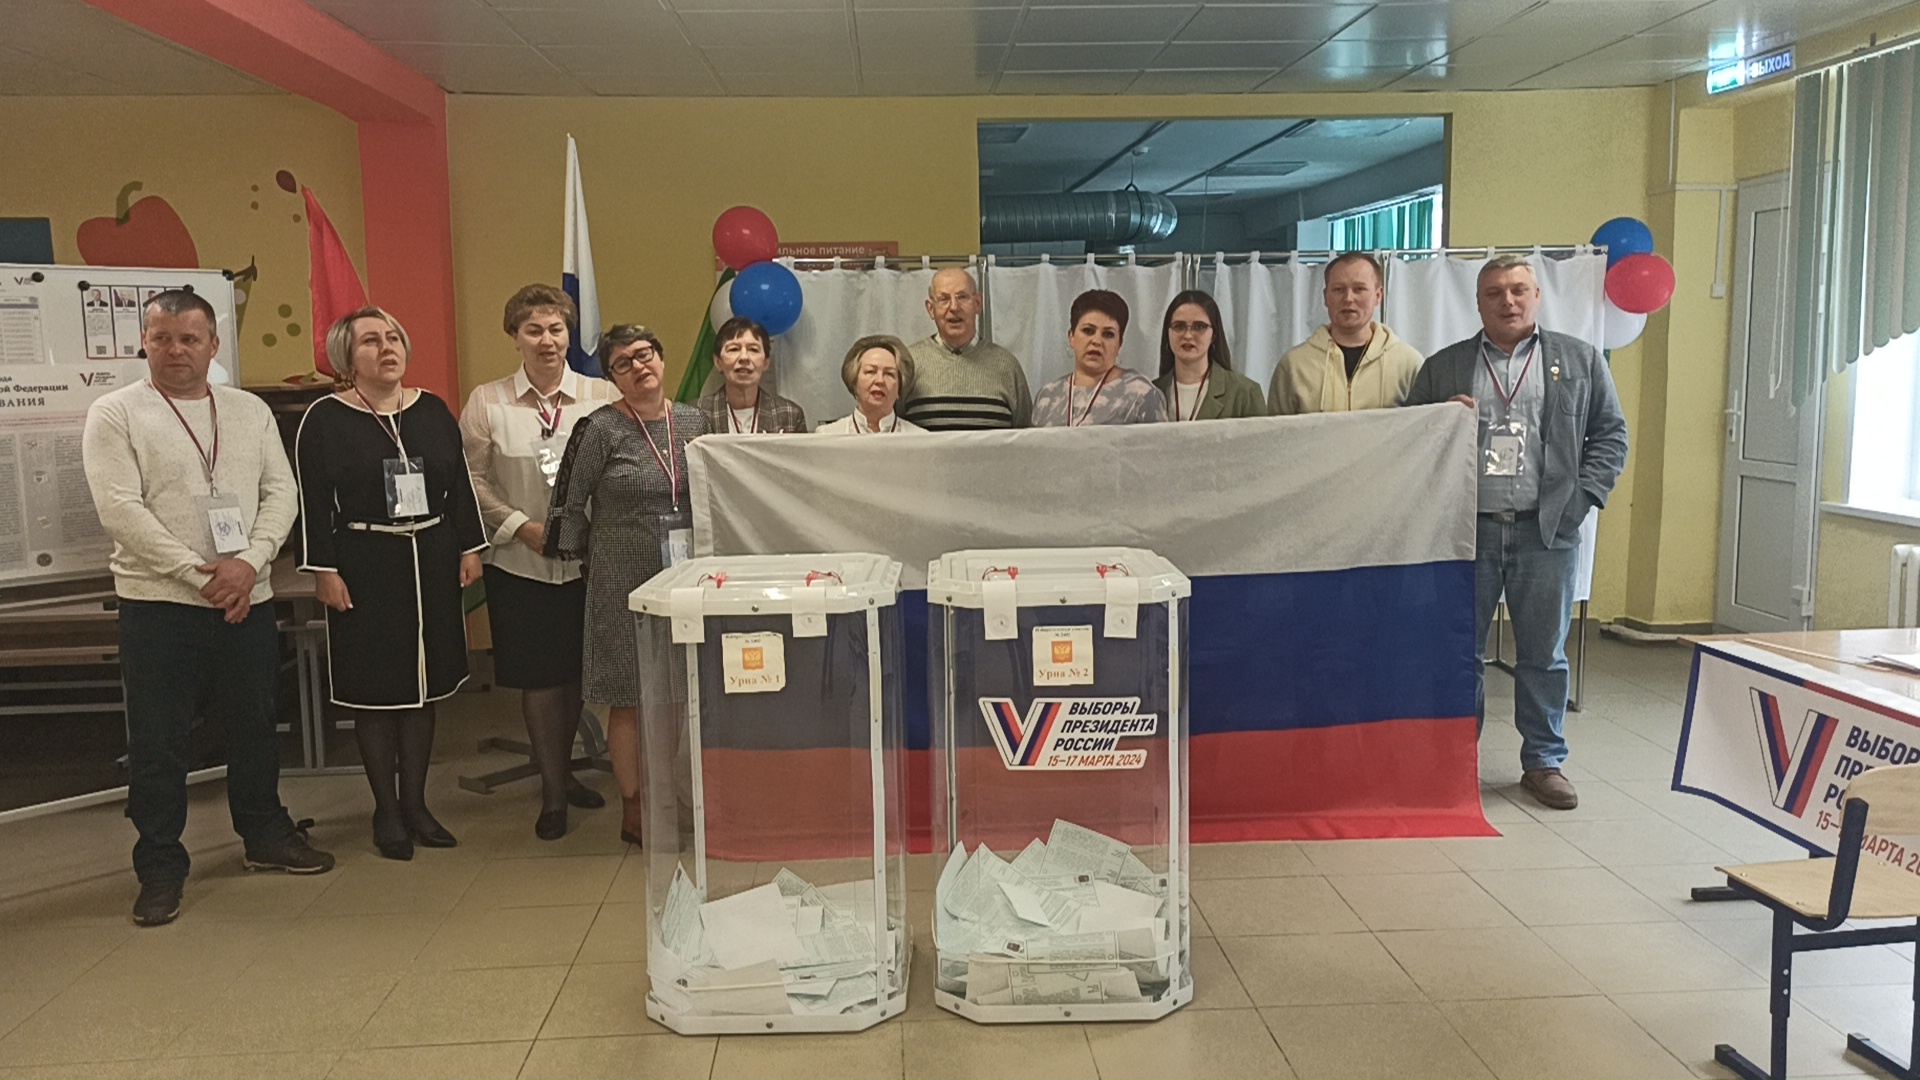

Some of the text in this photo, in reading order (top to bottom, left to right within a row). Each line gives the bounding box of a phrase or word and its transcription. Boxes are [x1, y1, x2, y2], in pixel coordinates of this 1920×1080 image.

[819, 246, 865, 255] питание
[13, 384, 68, 394] Федерации
[1038, 668, 1066, 680] Урна
[1083, 667, 1089, 677] 2
[729, 676, 757, 687] Урна
[1068, 702, 1136, 716] ВЫБОРЫ
[1060, 718, 1155, 734] ПРЕЗИДЕНТА
[1053, 738, 1115, 751] РОССИИ
[1078, 755, 1114, 767] МАРТА
[1115, 754, 1142, 766] 2024
